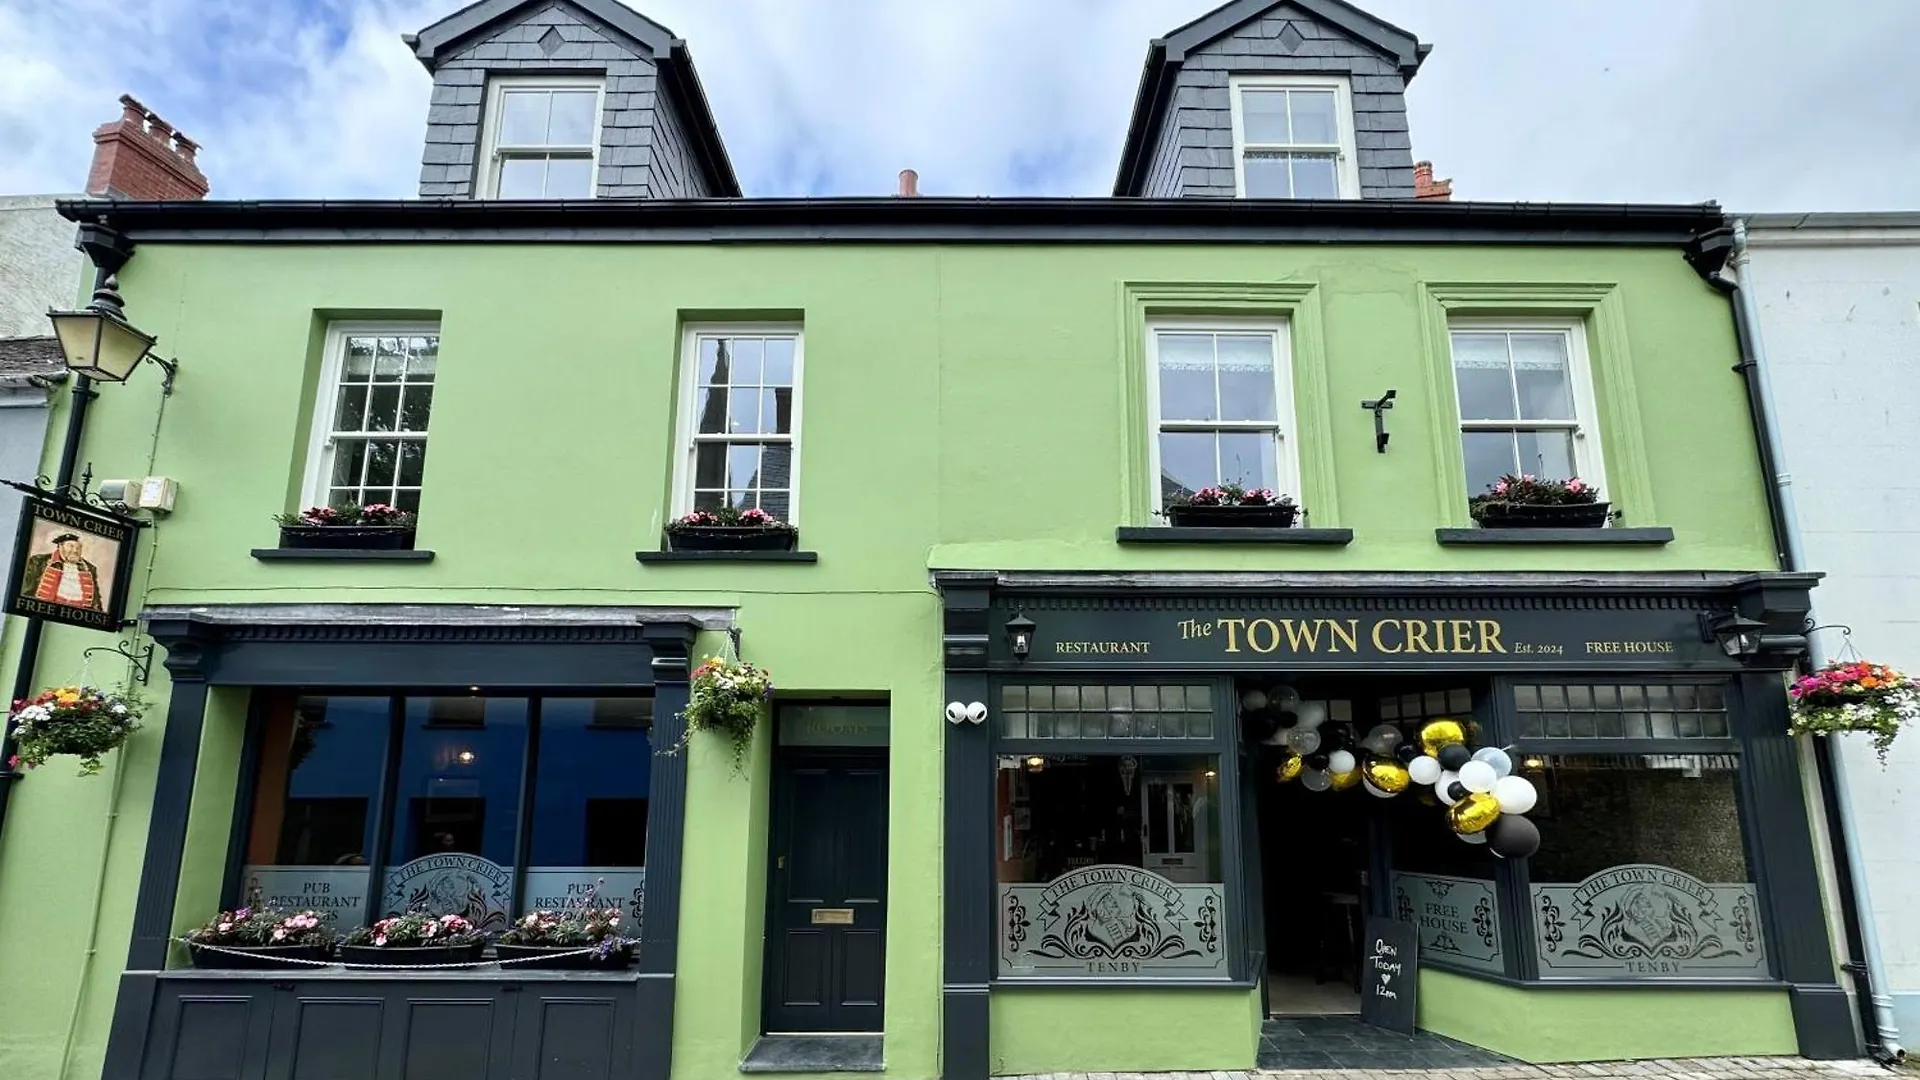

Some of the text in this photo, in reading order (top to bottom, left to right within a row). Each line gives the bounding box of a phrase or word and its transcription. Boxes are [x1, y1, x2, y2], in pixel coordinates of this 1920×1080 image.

[32, 504, 124, 540] TOWN CRIER
[16, 598, 111, 626] FREE HOUSE
[1056, 618, 1674, 656] RESTAURANT The TOWN CRIER Est. 2024 FREE HOUSE
[400, 857, 503, 881] THE TOWN CRIER
[303, 882, 331, 894] PUB
[567, 883, 594, 895] PUB
[1051, 869, 1173, 899] THE TOWN CRIER
[1580, 868, 1705, 899] THE TOWN CRIER
[269, 895, 361, 907] RESTAURANT
[1425, 903, 1459, 918] FREE
[1419, 916, 1469, 934] HOUSE
[1086, 962, 1141, 973] TENBY
[1624, 961, 1681, 973] TENBY
